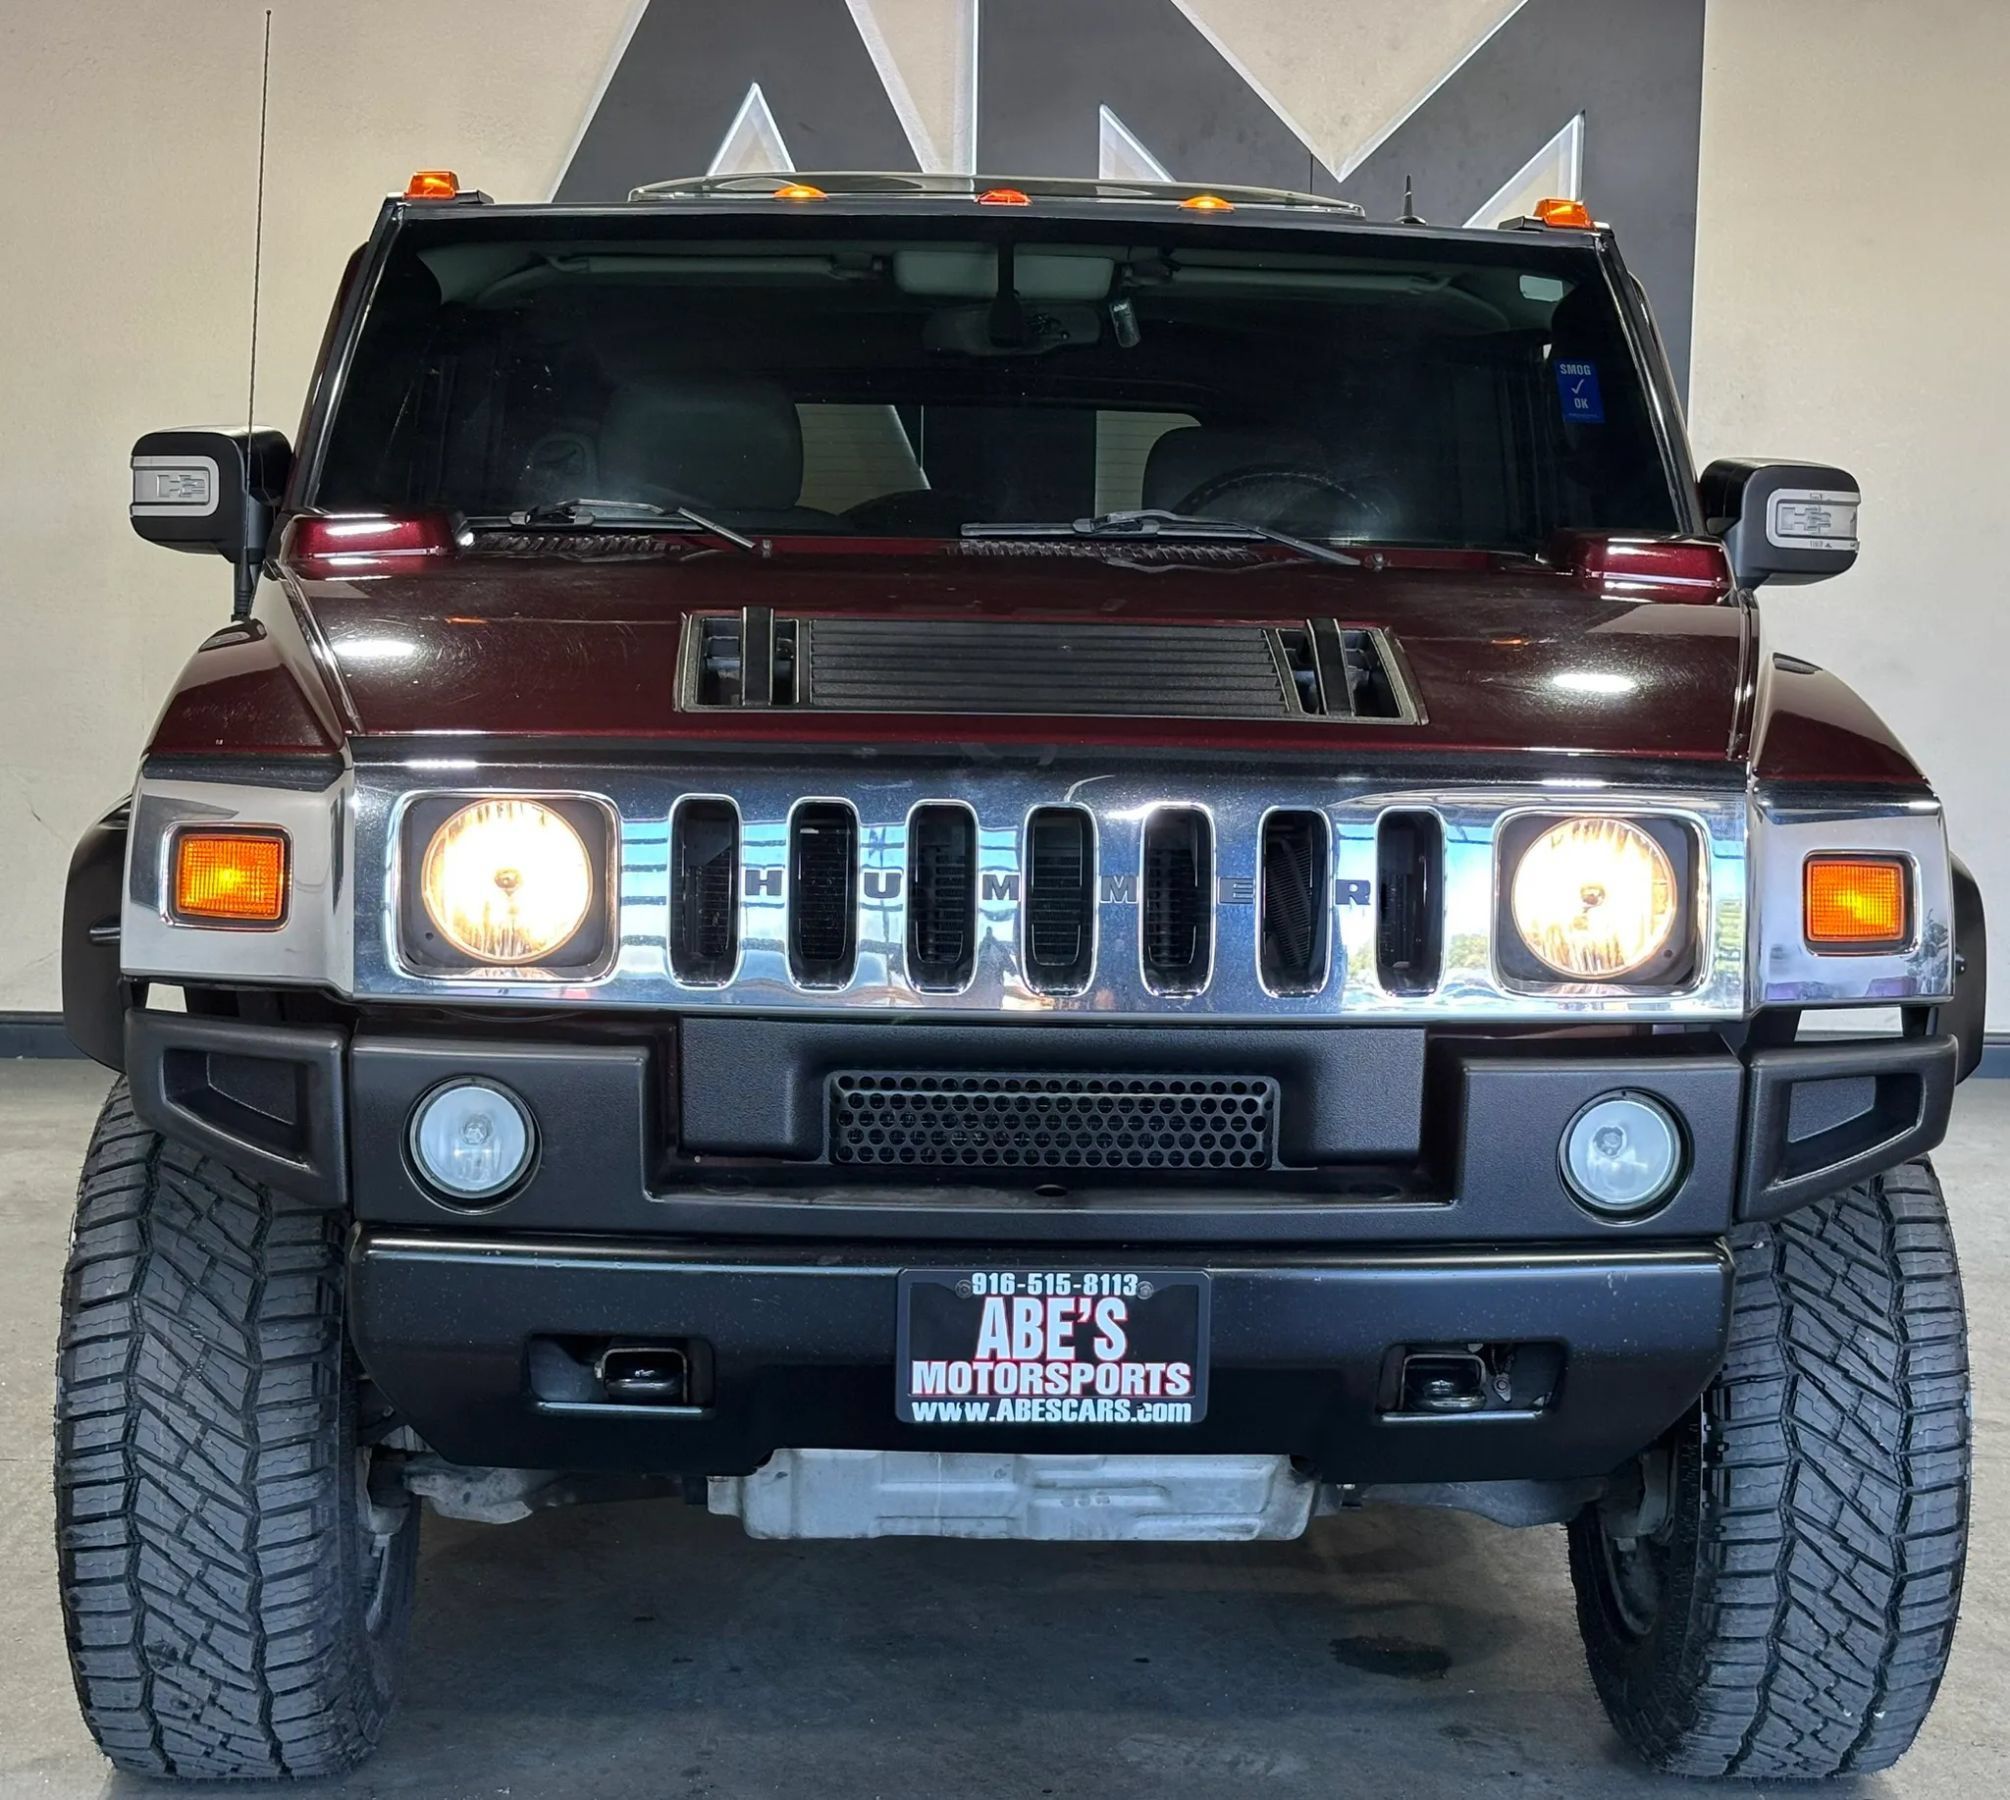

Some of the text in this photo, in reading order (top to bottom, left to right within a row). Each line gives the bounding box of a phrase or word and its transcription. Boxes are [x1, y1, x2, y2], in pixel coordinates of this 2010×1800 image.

[1559, 363, 1592, 375] SMOG
[1574, 397, 1589, 408] OK
[971, 1272, 1139, 1297] 916-515-8113
[974, 1296, 1129, 1361] ABE'S
[911, 1360, 1191, 1396] MOTORSPORTS
[911, 1398, 1192, 1423] www.ABESCARS.com
